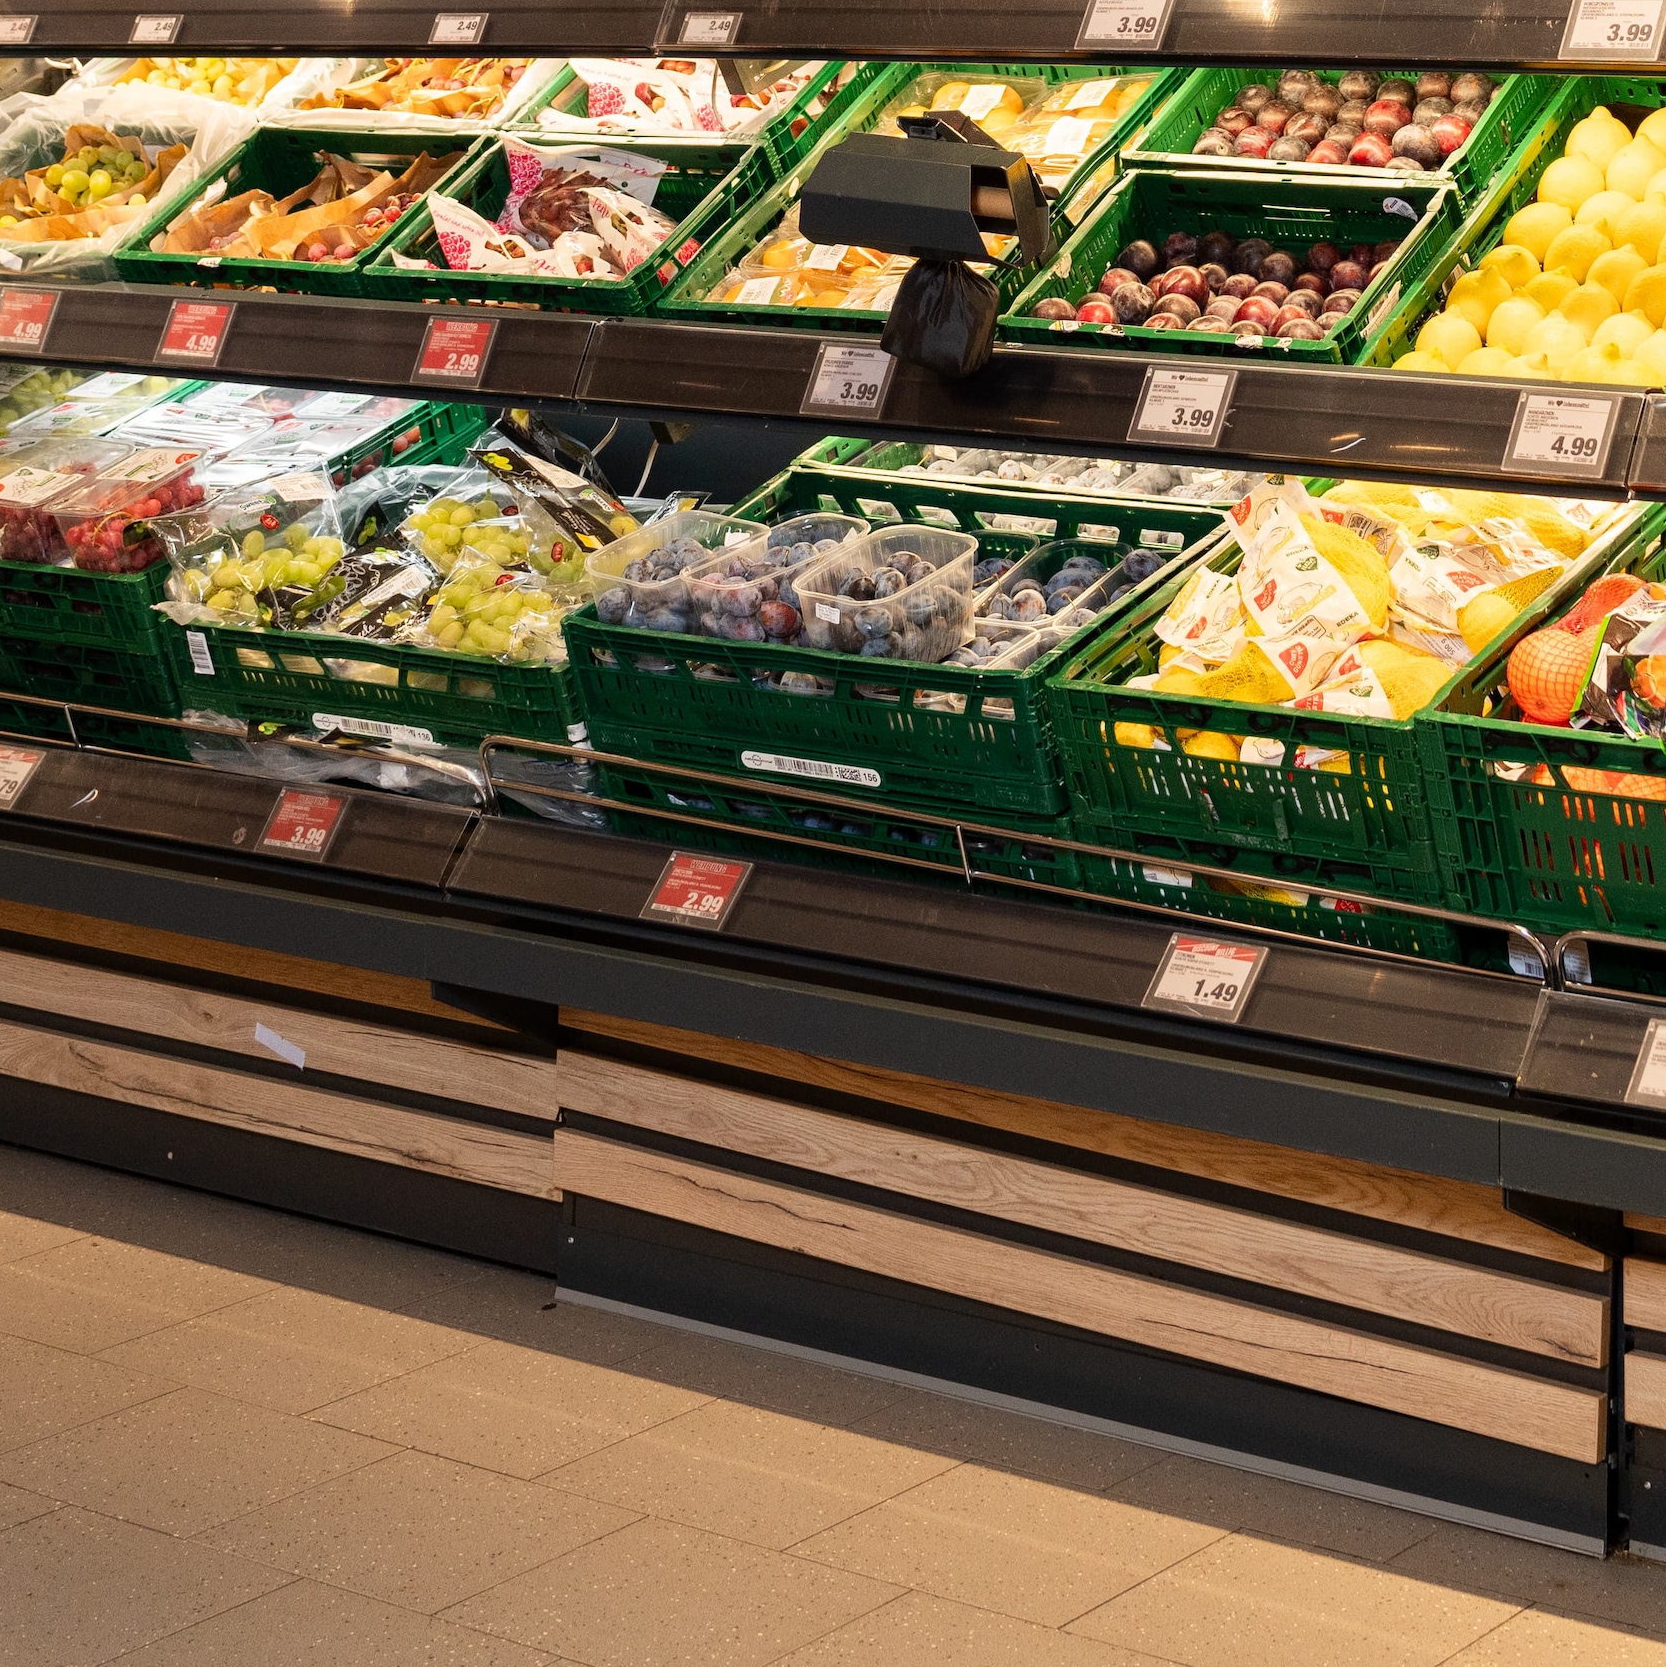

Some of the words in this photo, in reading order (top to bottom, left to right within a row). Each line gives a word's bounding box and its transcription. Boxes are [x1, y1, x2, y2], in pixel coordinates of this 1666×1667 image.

[10, 22, 29, 32] 2.49
[154, 22, 174, 32] 2.49
[457, 21, 478, 32] 2.49
[708, 20, 731, 32] 2.49
[1116, 17, 1157, 33] 3.99
[1606, 24, 1652, 42] 3.99
[13, 322, 43, 339] 4.99
[446, 322, 478, 333] WERBUNG
[185, 334, 218, 352] 4.99
[444, 353, 480, 371] 2.99
[840, 382, 879, 401] 3.99
[1171, 407, 1214, 428] 3.99
[1550, 435, 1598, 457] 4.99
[1336, 611, 1359, 628] EDEKA
[417, 732, 431, 742] 136
[863, 772, 878, 783] 156
[290, 825, 327, 846] 3.99
[690, 860, 728, 873] WERBUNG
[682, 892, 724, 913] 2.99
[1193, 979, 1238, 1002] 1.49
